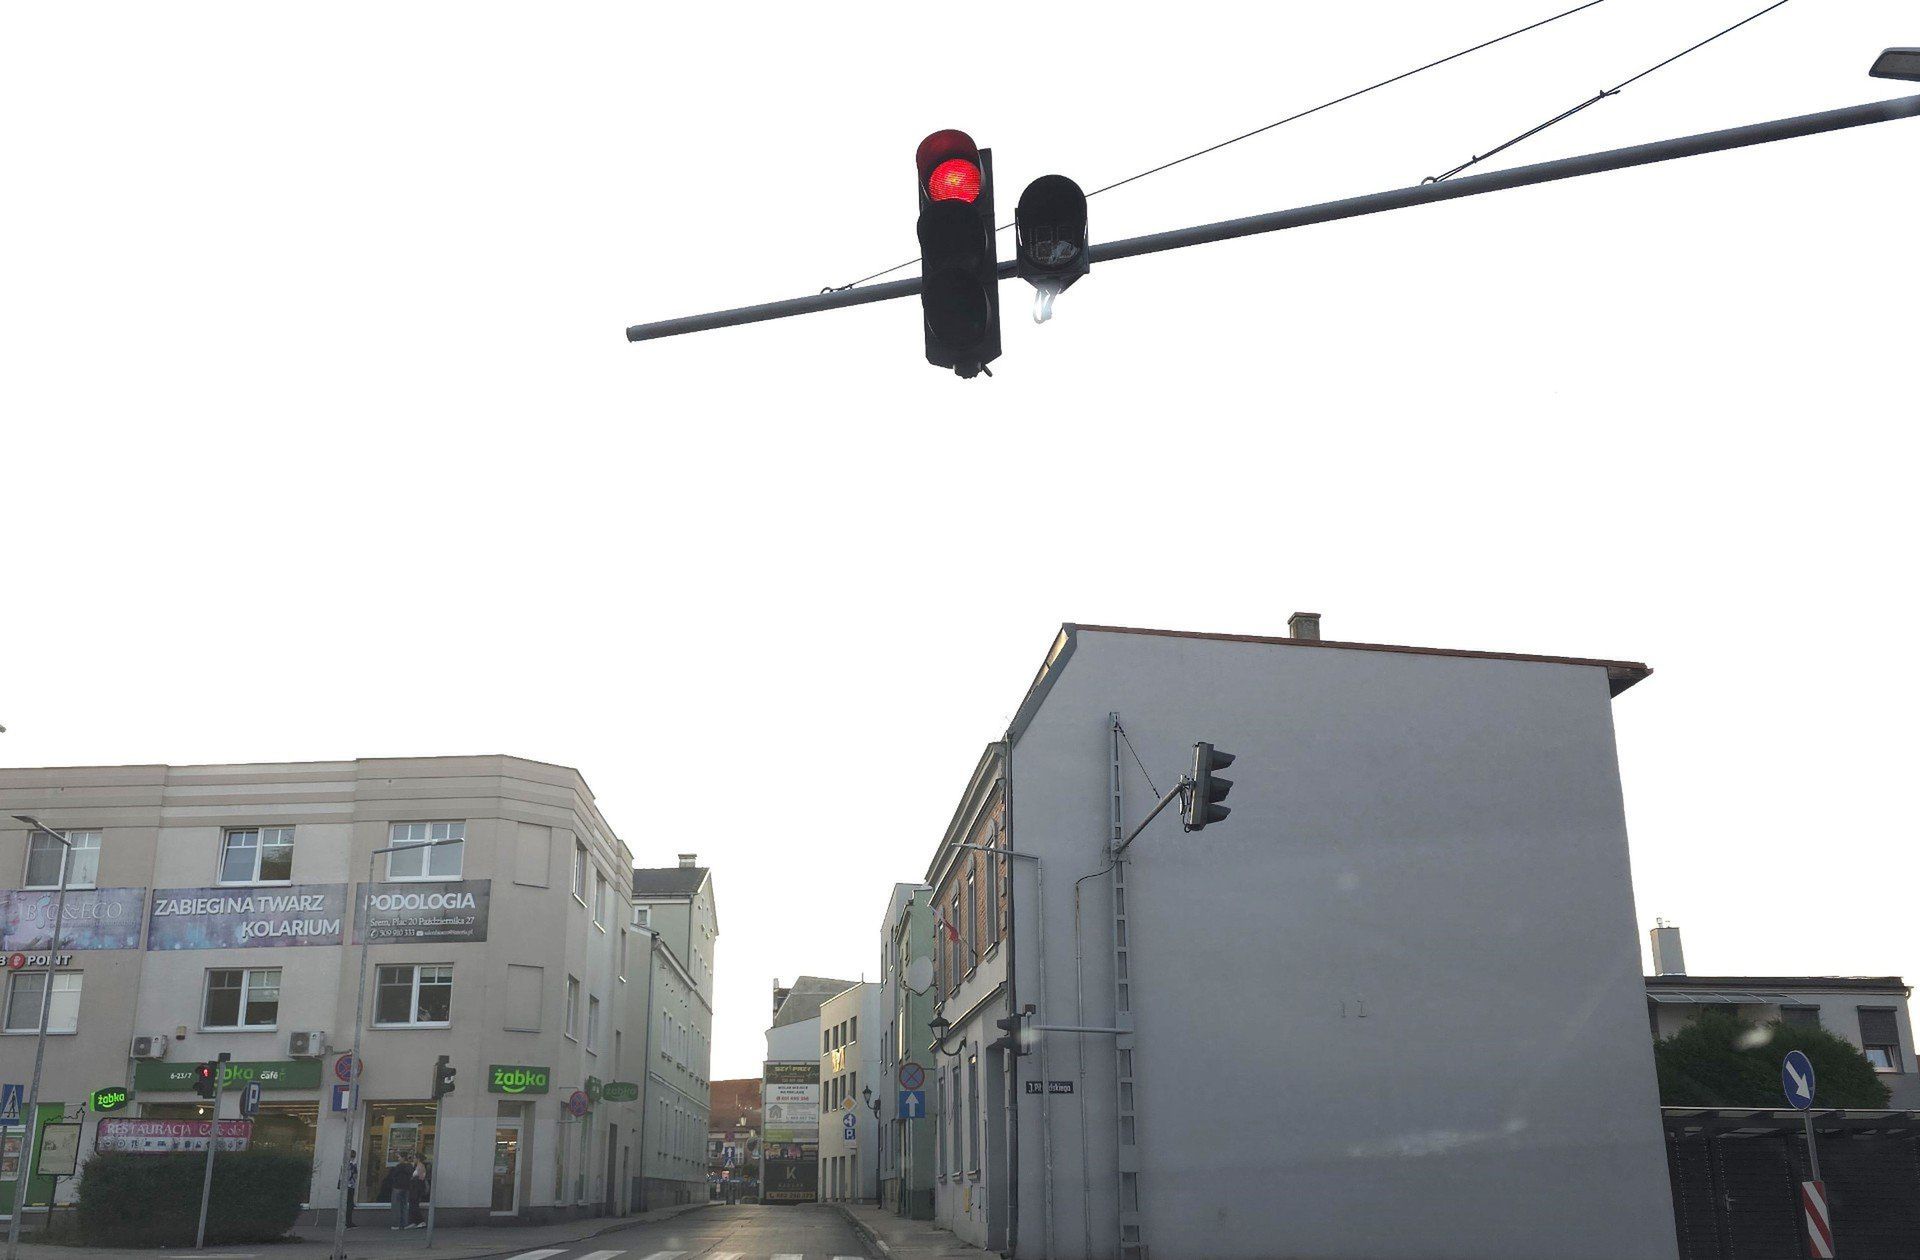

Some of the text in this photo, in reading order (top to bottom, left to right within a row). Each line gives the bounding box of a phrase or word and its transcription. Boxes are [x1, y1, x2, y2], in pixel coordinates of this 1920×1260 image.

[154, 894, 324, 916] ZABIEGI NA TWARZ
[365, 893, 476, 912] PODOLOGIA
[408, 917, 418, 926] 20
[465, 916, 475, 925] 27
[241, 919, 340, 938] KOLARIUM
[27, 955, 72, 966] POINT
[260, 1070, 278, 1080] café
[494, 1068, 546, 1086] żabka
[98, 1092, 125, 1105] żabka
[106, 1122, 192, 1136] RESTAURACJA
[786, 1166, 796, 1179] K
